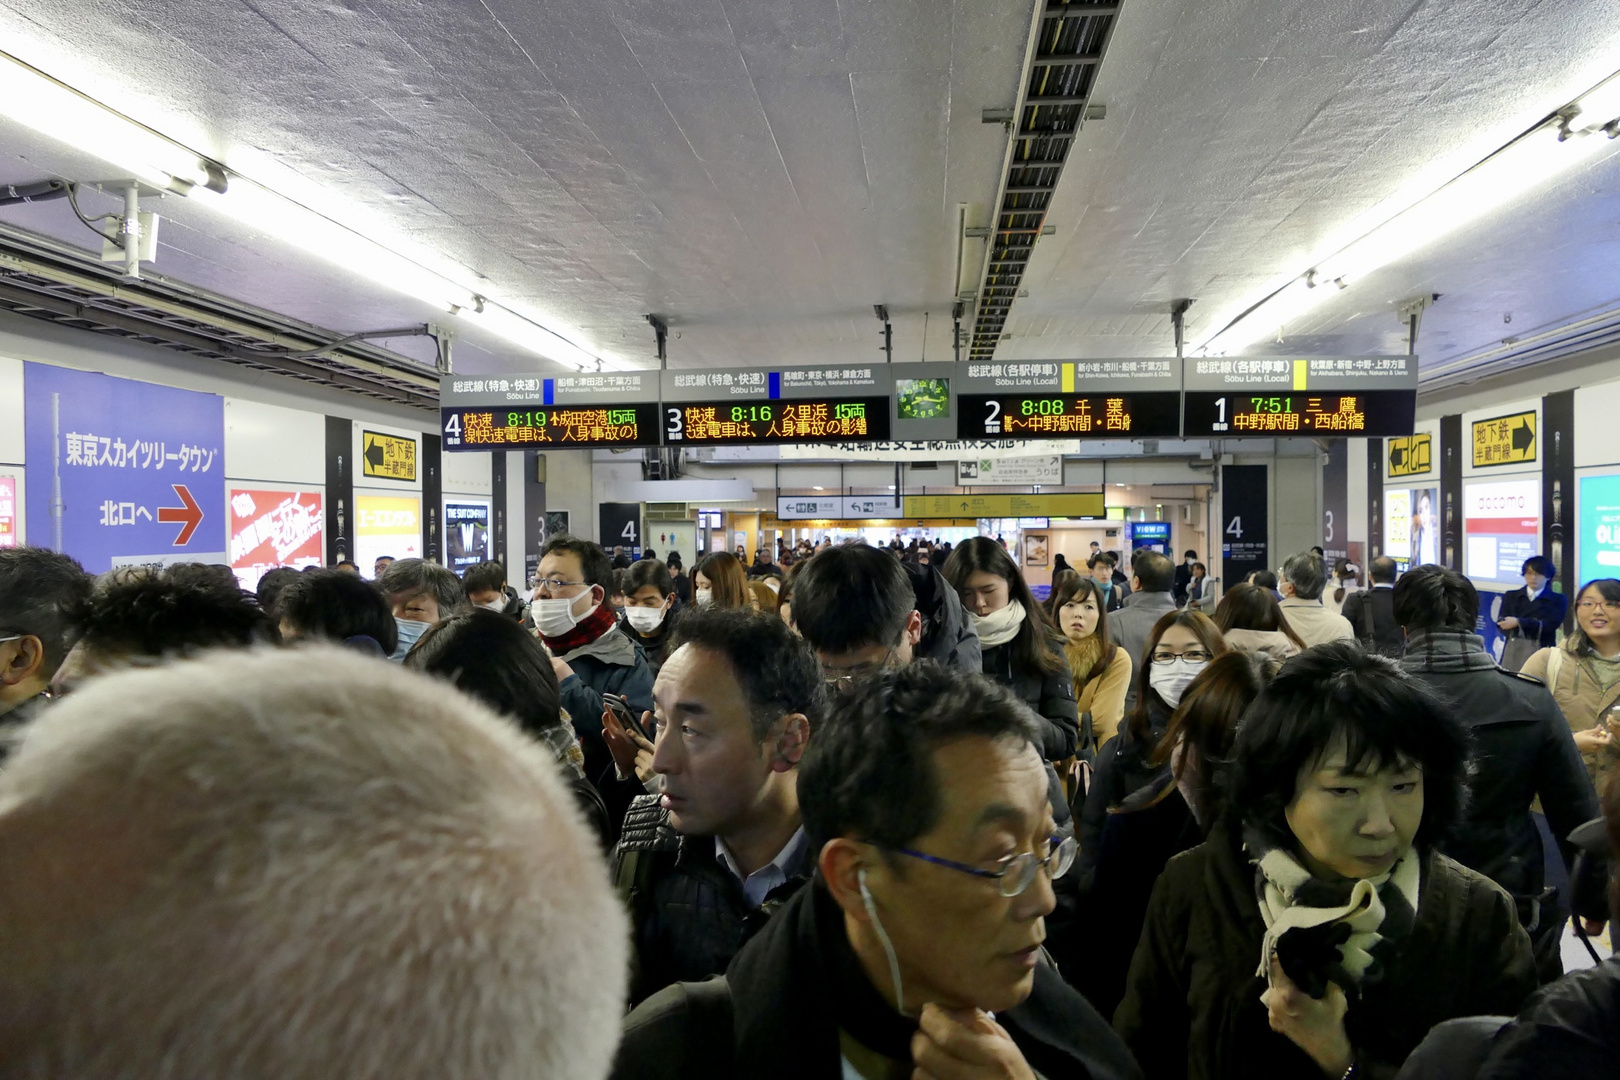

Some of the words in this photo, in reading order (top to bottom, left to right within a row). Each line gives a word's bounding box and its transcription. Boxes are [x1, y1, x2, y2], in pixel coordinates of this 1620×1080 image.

[1033, 377, 1058, 386] (Local)
[1264, 374, 1290, 383] (Local)
[525, 391, 539, 400] Line
[750, 386, 765, 394] Line
[731, 406, 772, 422] 8:16
[783, 403, 828, 421] 久里浜
[834, 403, 866, 420] 15両
[984, 401, 1001, 425] 2
[1021, 399, 1064, 416] 8:08
[1214, 397, 1226, 422] 1
[1251, 397, 1293, 414] 7:51
[463, 412, 493, 428] 快速
[507, 411, 547, 427] 8:19
[559, 409, 607, 427] 成田空港
[607, 408, 637, 425] 15両
[667, 408, 683, 433] 3
[685, 406, 716, 424] 快速
[445, 413, 462, 437] 4
[1476, 420, 1510, 445] 地下鉄
[66, 431, 214, 473] 東京スカイツリータウン
[384, 437, 414, 461] 地下鉄
[1475, 443, 1512, 463] 半蔵門線
[383, 459, 414, 477] 半蔵門線
[1035, 467, 1060, 477] うりば
[1478, 494, 1526, 511] docomo
[100, 500, 153, 527] 北口へ
[447, 507, 457, 519] THE
[537, 516, 546, 547] 3
[620, 520, 637, 542] 4
[1225, 516, 1244, 538] 4
[1325, 510, 1334, 542] 3
